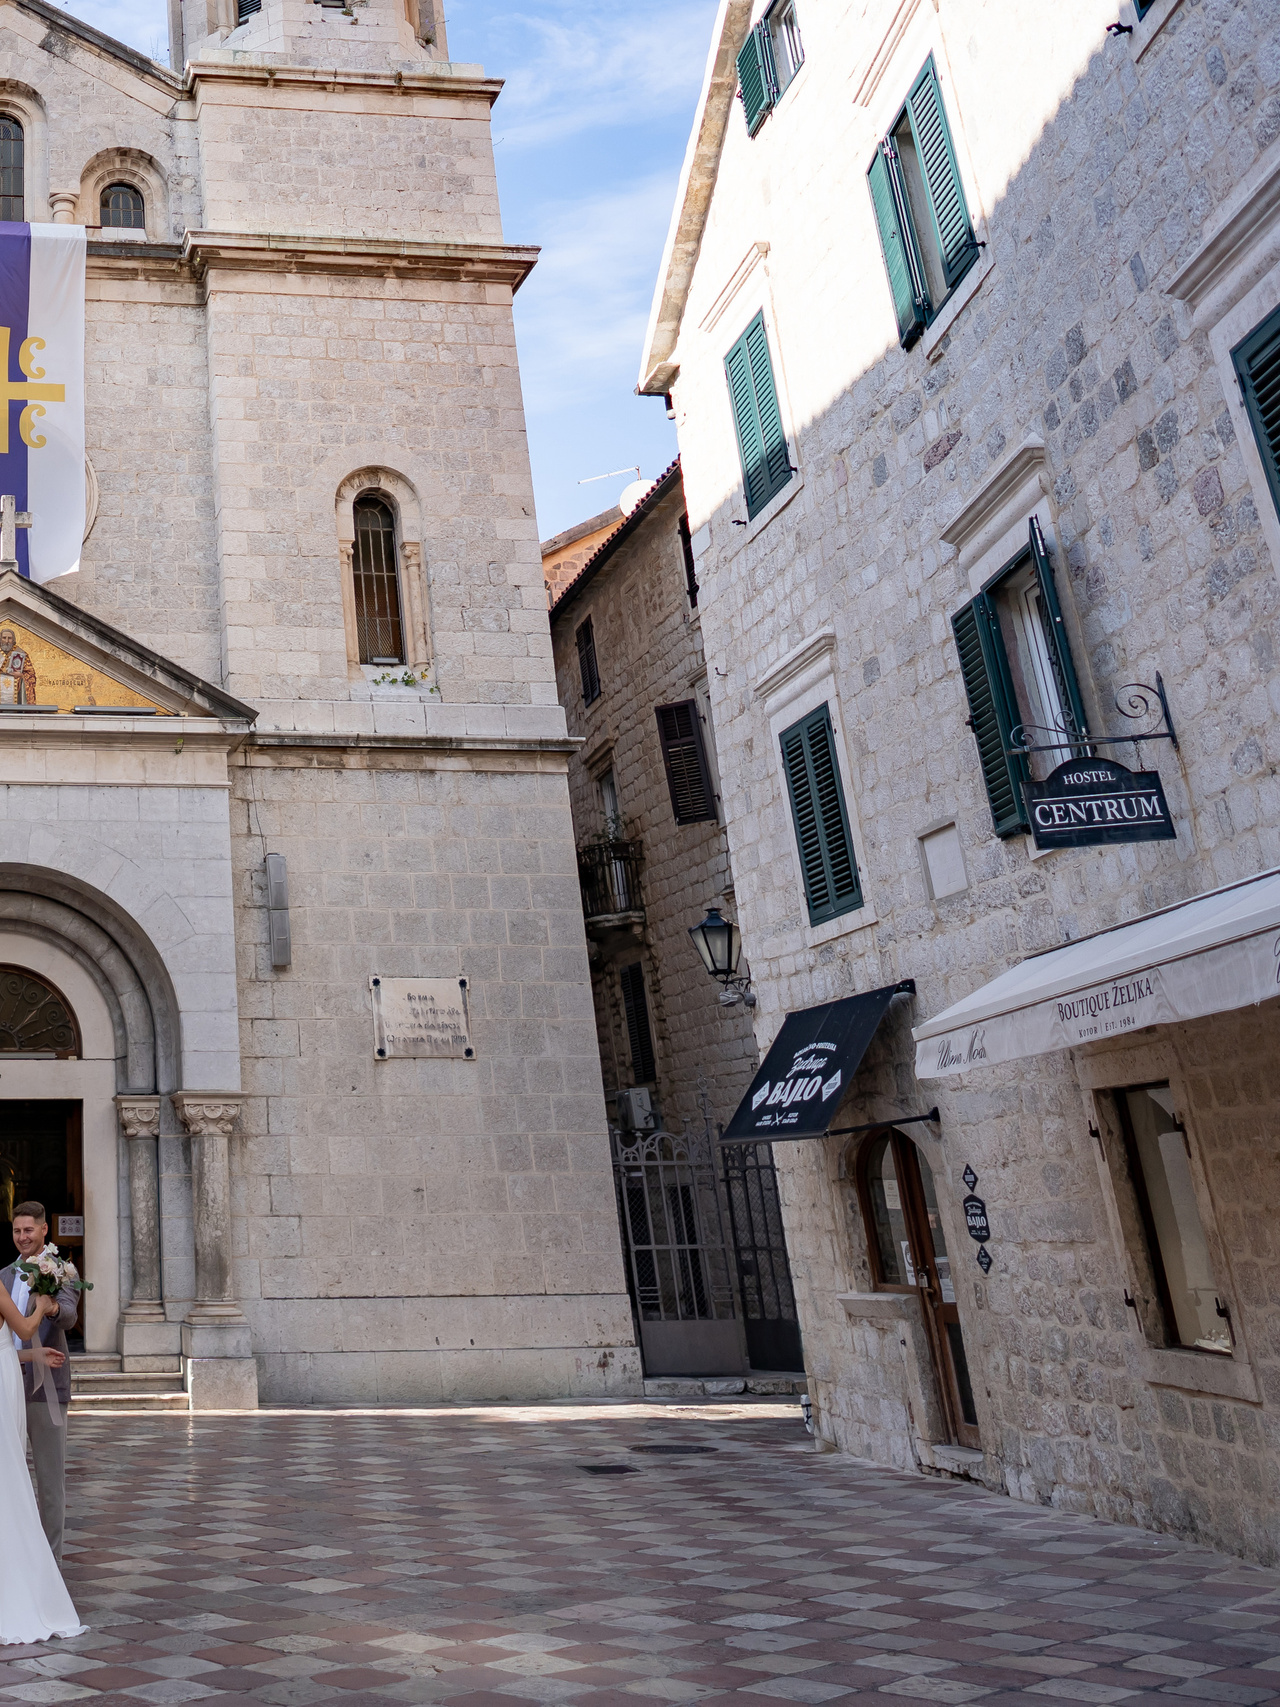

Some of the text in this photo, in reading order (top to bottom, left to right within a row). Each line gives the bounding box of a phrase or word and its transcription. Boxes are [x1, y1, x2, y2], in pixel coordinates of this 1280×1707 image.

[1063, 770, 1116, 785] HOSTEL
[1034, 796, 1164, 826] CENTRUM
[1057, 991, 1111, 1022] BOUTIQUE
[1078, 1026, 1098, 1038] KOTOR
[1120, 1016, 1136, 1028] 1984
[765, 1075, 823, 1107] BAJLO
[967, 1215, 987, 1228] BAJLO
